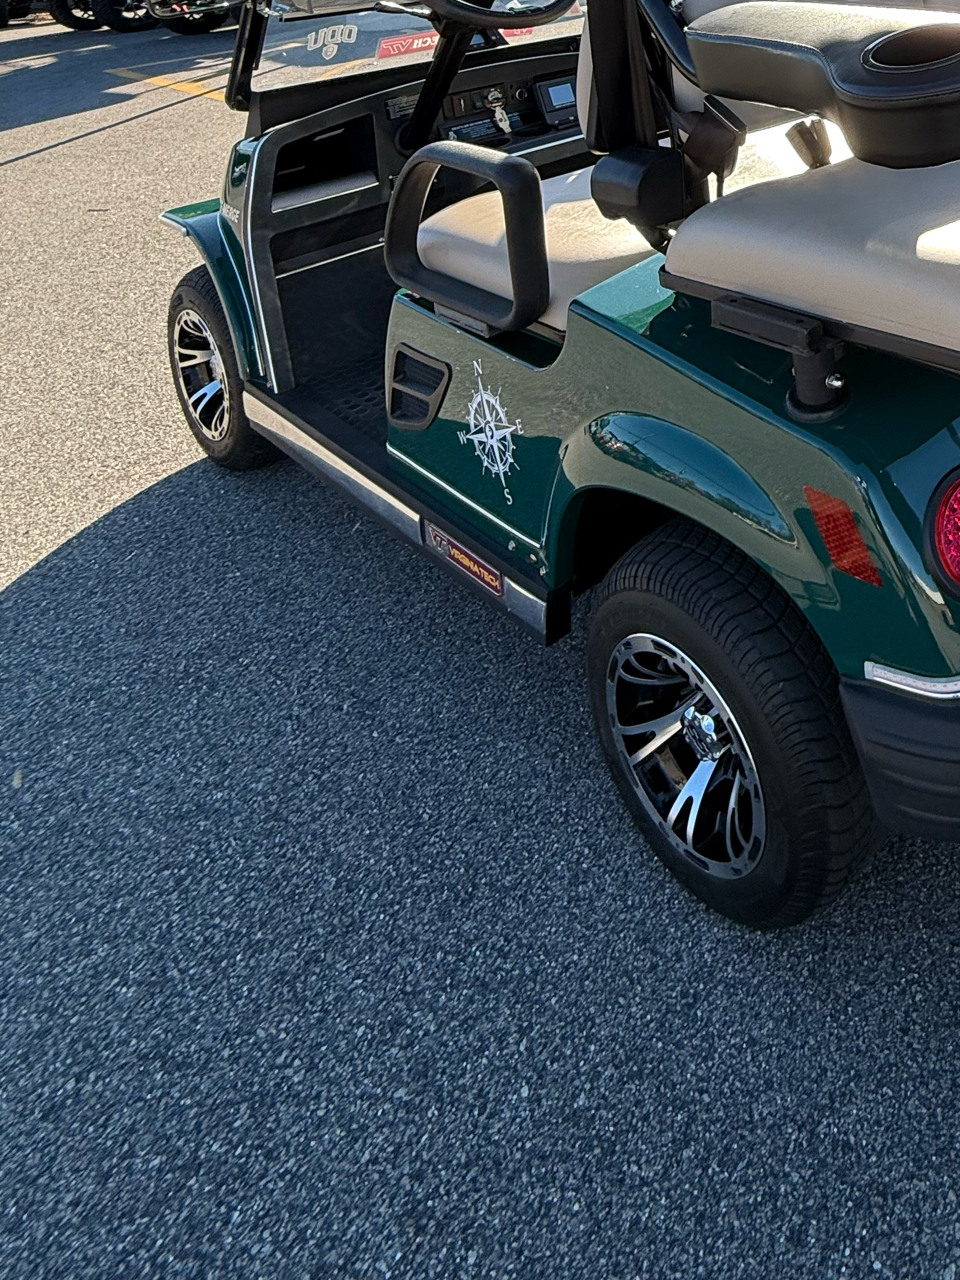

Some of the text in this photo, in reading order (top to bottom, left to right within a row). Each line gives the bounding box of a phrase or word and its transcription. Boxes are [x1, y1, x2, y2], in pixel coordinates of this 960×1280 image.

[472, 358, 483, 376] N
[515, 418, 525, 435] E
[456, 430, 468, 445] W
[503, 488, 513, 505] S
